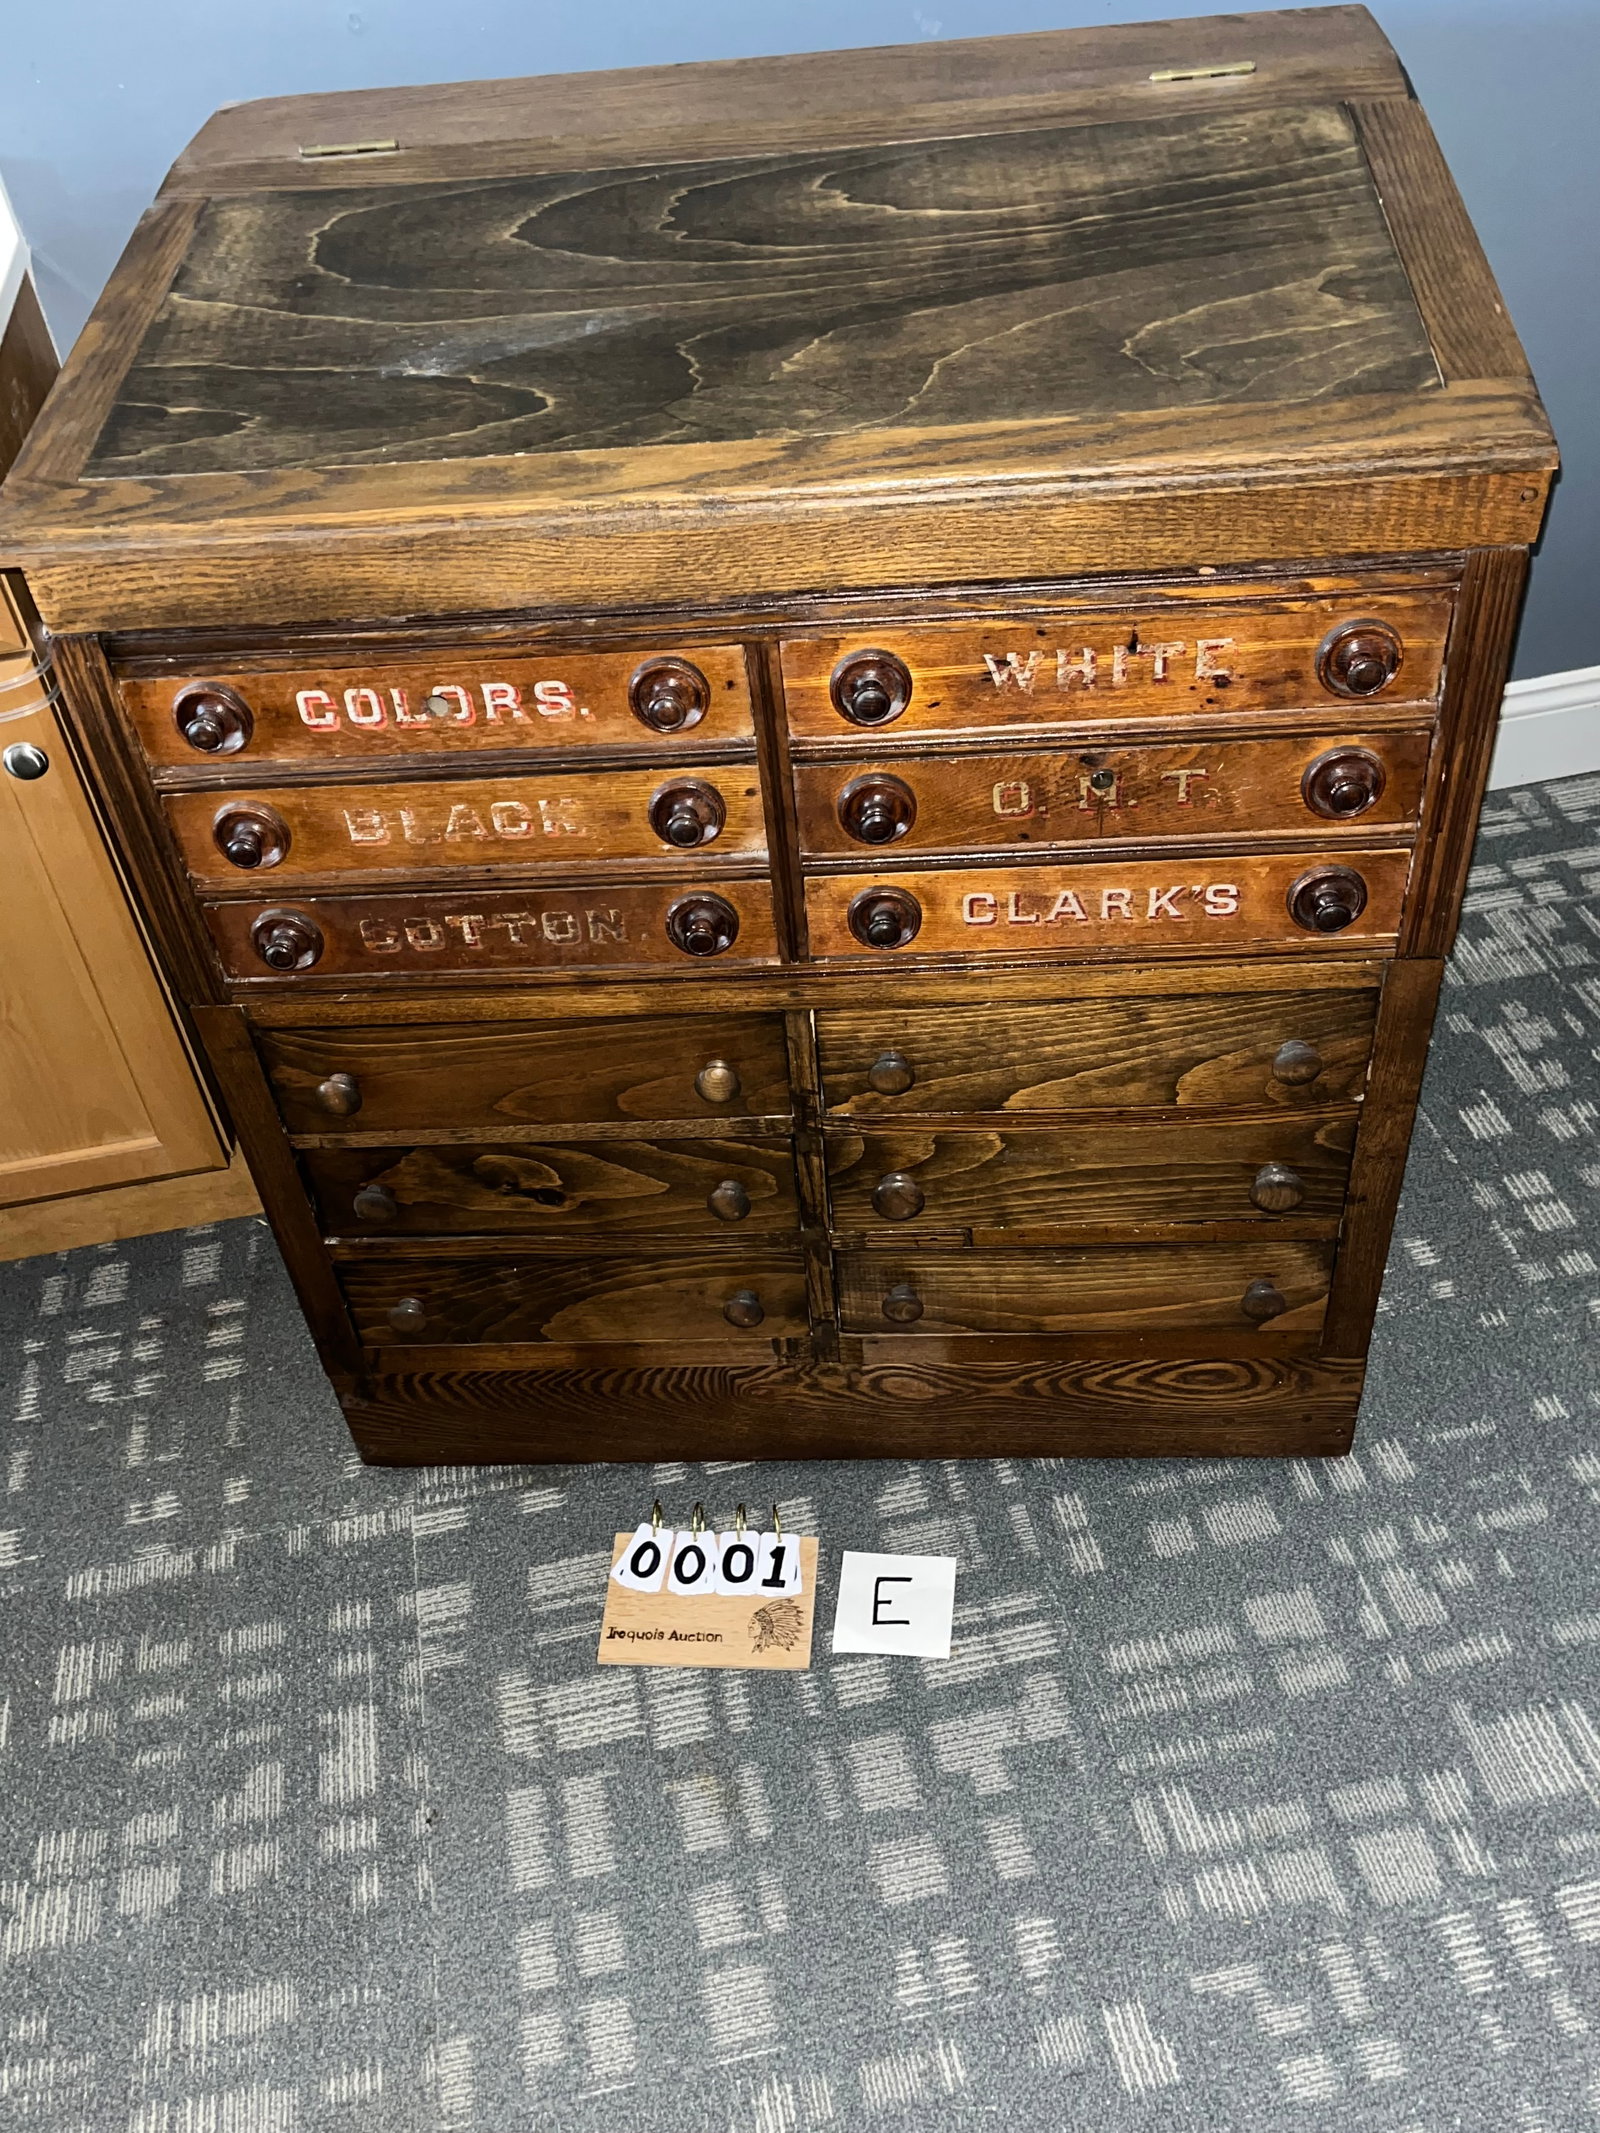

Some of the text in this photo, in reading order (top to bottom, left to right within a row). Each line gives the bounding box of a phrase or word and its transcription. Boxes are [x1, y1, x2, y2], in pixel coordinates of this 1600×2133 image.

[983, 638, 1240, 696] WHITE
[342, 798, 587, 846] BLACK
[962, 883, 1243, 926] CLARK'S
[629, 1541, 786, 1588] 0001
[872, 1576, 913, 1626] E
[667, 1630, 723, 1643] Auction
